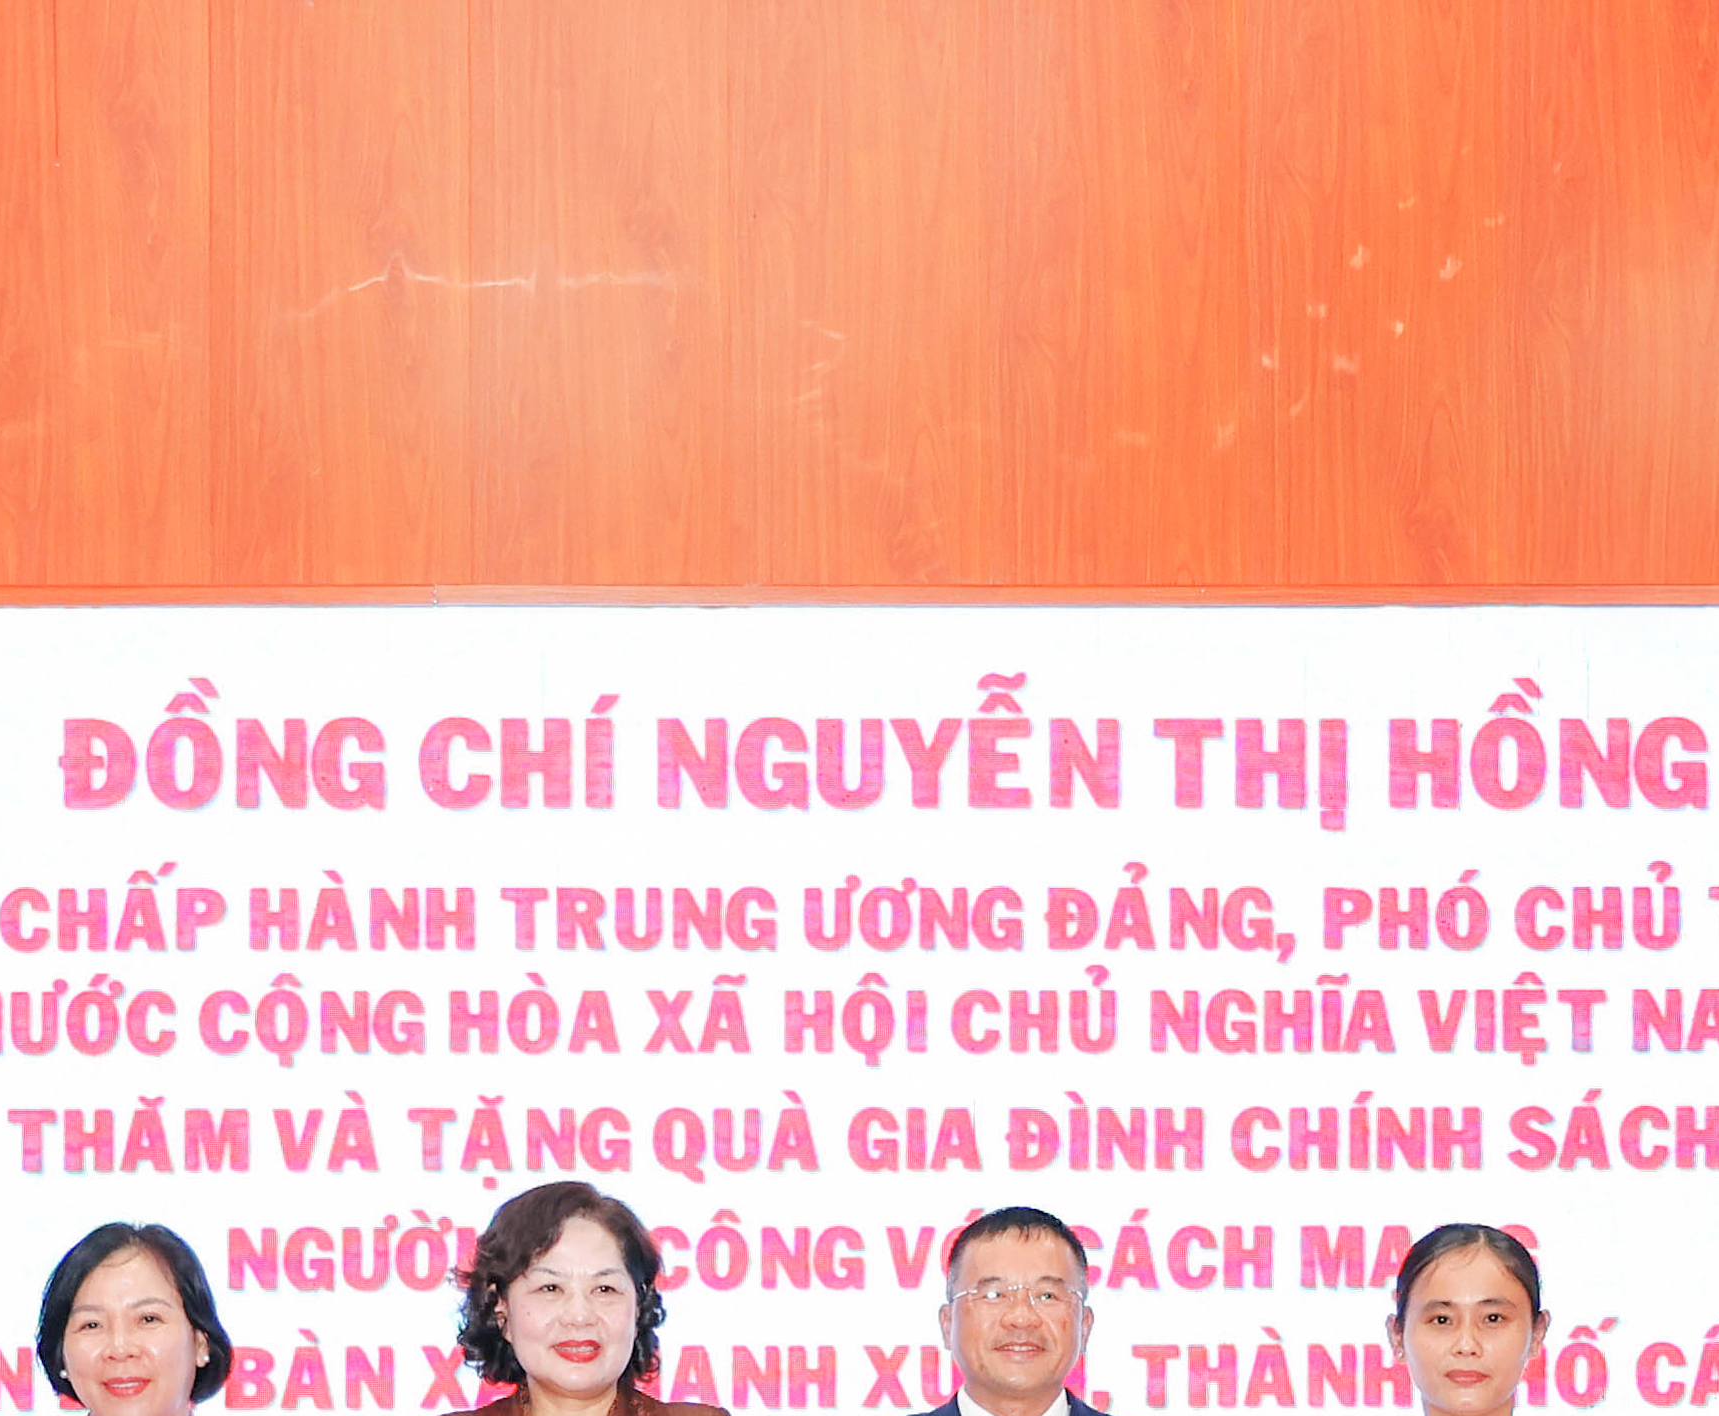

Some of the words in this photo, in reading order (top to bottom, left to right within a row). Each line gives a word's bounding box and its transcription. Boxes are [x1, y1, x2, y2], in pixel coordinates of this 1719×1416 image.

[58, 677, 385, 810] ĐỒNG
[418, 694, 618, 809] CHÍ
[657, 672, 1120, 810] NGUYỄN
[1154, 718, 1348, 831] THỊ
[1388, 677, 1708, 810] HỒNG
[0, 861, 226, 952] CHẤP
[249, 870, 476, 951] HÀNH
[500, 886, 777, 951] TRUNG
[804, 875, 1023, 951] ƯƠNG
[1044, 861, 1296, 963] ĐẢNG,
[1323, 869, 1490, 951] PHÓ
[1514, 860, 1681, 951] CHỦ
[199, 973, 425, 1067] CỘNG
[449, 972, 619, 1054] HÒA
[646, 974, 750, 1053] XÃ
[784, 972, 927, 1066] HỘI
[951, 967, 1117, 1054] CHỦ
[1150, 973, 1395, 1054] NGHĨA
[1418, 971, 1607, 1066] VIỆT
[7, 1096, 249, 1172] THĂM
[273, 1091, 378, 1172] VÀ
[407, 1095, 631, 1189] TẶNG
[652, 1090, 818, 1183] QUÀ
[847, 1106, 982, 1172] GIA
[1005, 1091, 1204, 1171] ĐÌNH
[1231, 1090, 1482, 1172] CHÍNH
[650, 1209, 865, 1291] CÔNG
[225, 1328, 394, 1410] BÀN
[1132, 1326, 1413, 1407] THÀNH
